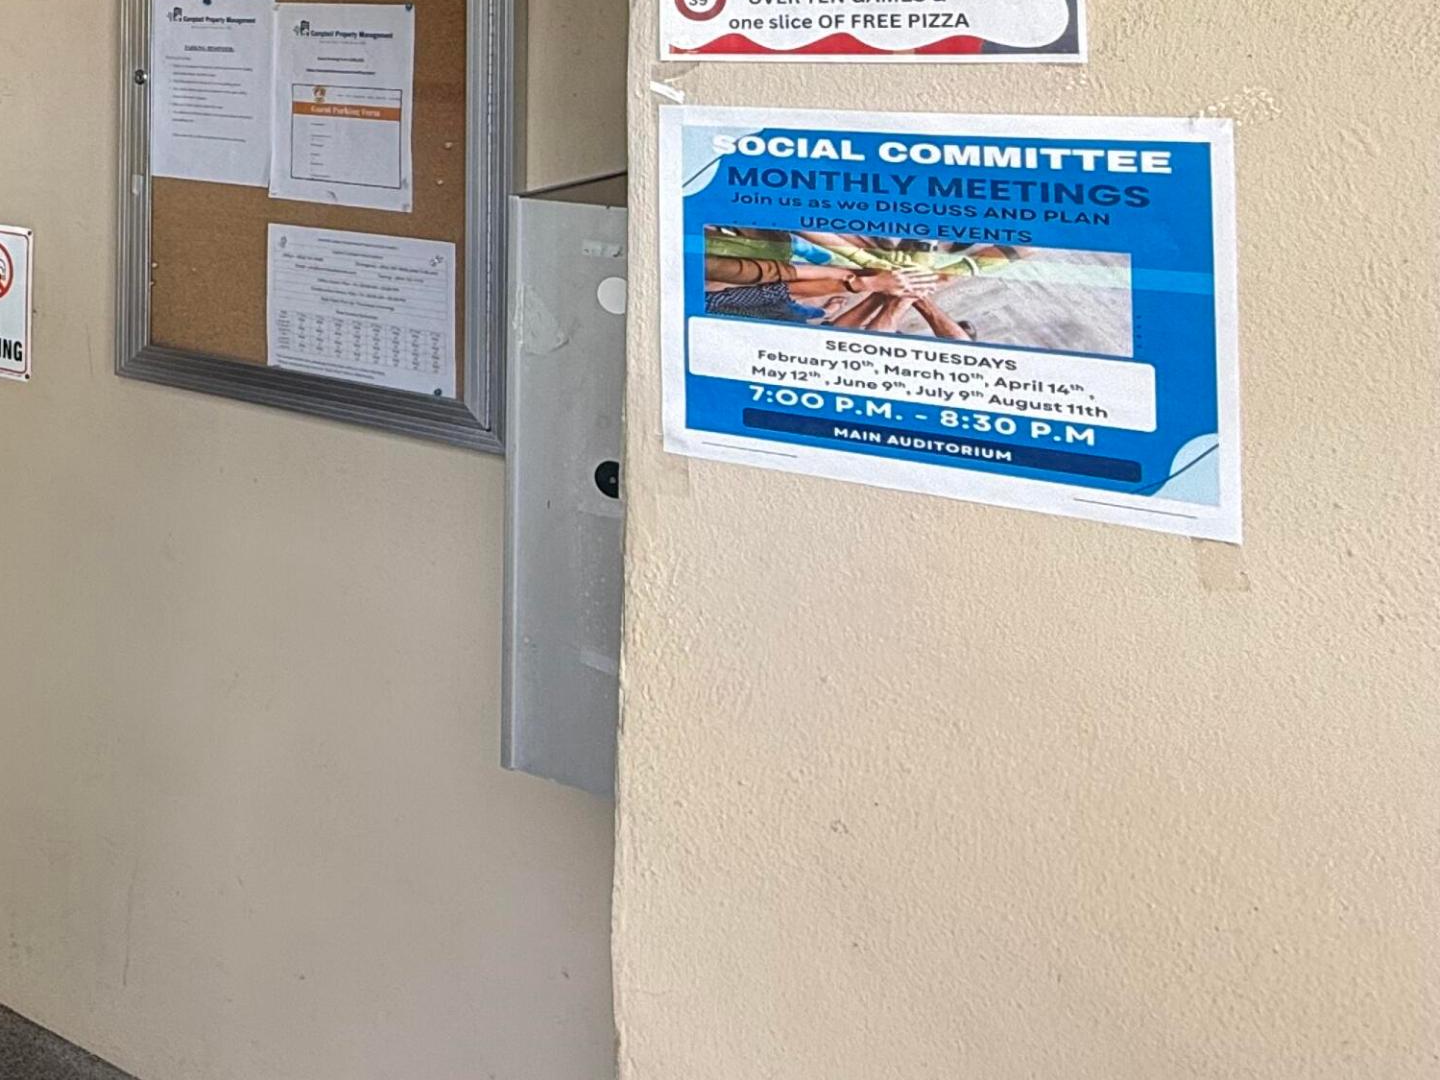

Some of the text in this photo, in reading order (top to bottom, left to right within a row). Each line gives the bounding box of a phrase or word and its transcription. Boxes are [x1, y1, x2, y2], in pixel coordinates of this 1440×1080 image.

[729, 12, 970, 30] one slice OF FREE PIZZA
[712, 134, 1172, 174] SOCIAL COMMITTEE
[728, 166, 1150, 208] MONTHLY MEETINGS
[731, 192, 1110, 226] Join us as we DISCUSS AND PLAN
[800, 216, 1032, 243] UPCOMING EVENTS
[758, 350, 837, 370] February
[884, 364, 945, 382] March
[994, 377, 1043, 392] April
[825, 340, 1017, 371] SECOND TUESDAYS
[752, 365, 787, 381] May
[833, 376, 878, 390] June
[915, 385, 954, 401] July
[958, 390, 985, 401] 9th
[988, 394, 1063, 411] August
[1066, 404, 1108, 419] 11th
[749, 384, 825, 409] 7:00
[835, 396, 903, 420] P.M.
[940, 410, 1017, 435] 8:30
[1030, 421, 1095, 446] P.M
[834, 427, 1012, 461] MAIN AUDITORIUM
